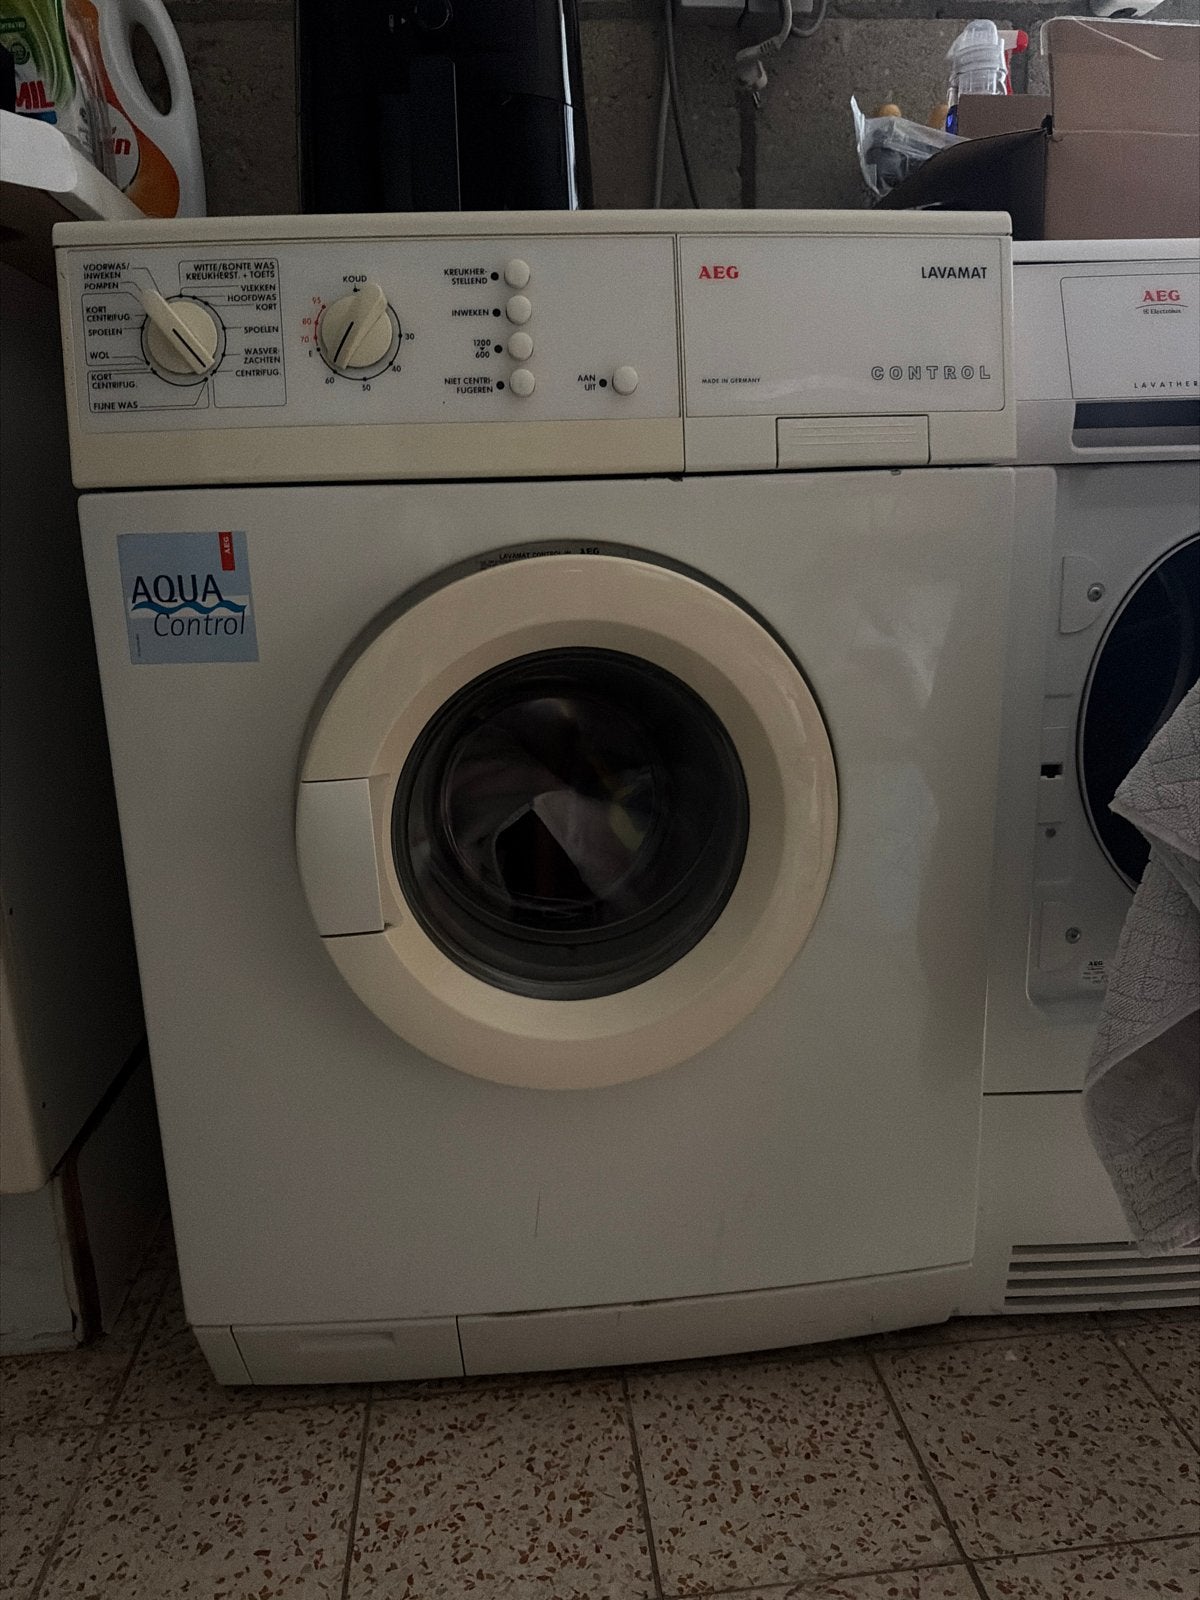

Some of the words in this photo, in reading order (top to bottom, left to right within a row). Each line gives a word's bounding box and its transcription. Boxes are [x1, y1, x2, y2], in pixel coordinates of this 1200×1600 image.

[83, 262, 130, 271] VOORWAS/
[194, 262, 252, 271] WITTE/BONTE
[254, 262, 275, 270] WAS
[84, 270, 121, 279] INWEKEN
[186, 272, 240, 281] KREUKHERST.
[250, 270, 275, 279] TOETS
[444, 268, 488, 277] KREUKHER-
[698, 265, 740, 280] AEG
[921, 266, 987, 279] LAVAMAT
[342, 275, 368, 283] KOUD
[451, 276, 488, 285] STELLEND
[84, 282, 119, 290] POMPEN
[240, 284, 276, 292] VLEKKEN
[227, 294, 277, 302] HOOFDWAS
[1143, 290, 1181, 302] AEG
[256, 303, 277, 311] KORT
[452, 308, 489, 317] INWEKEN
[86, 313, 132, 322] CENTRIFUG.
[88, 328, 123, 336] SPOELEN
[244, 326, 279, 334] SPOELEN
[474, 339, 491, 347] 1200
[90, 352, 110, 360] WOL
[475, 350, 490, 359] 600
[243, 356, 281, 364] ZACHTEN
[235, 369, 281, 377] CENTRIFUG.
[871, 365, 991, 381] CONTROL
[444, 377, 461, 385] NIET
[463, 376, 494, 385] CENTRI-
[578, 374, 596, 383] AAN
[92, 381, 138, 389] CENTRIFUG.
[584, 383, 596, 391] UIT
[456, 386, 494, 394] FUGEREN
[94, 402, 115, 410] FIJNE
[116, 401, 138, 409] WAS
[222, 536, 231, 555] AEG
[132, 574, 224, 604] AQUA
[154, 610, 246, 637] Control
